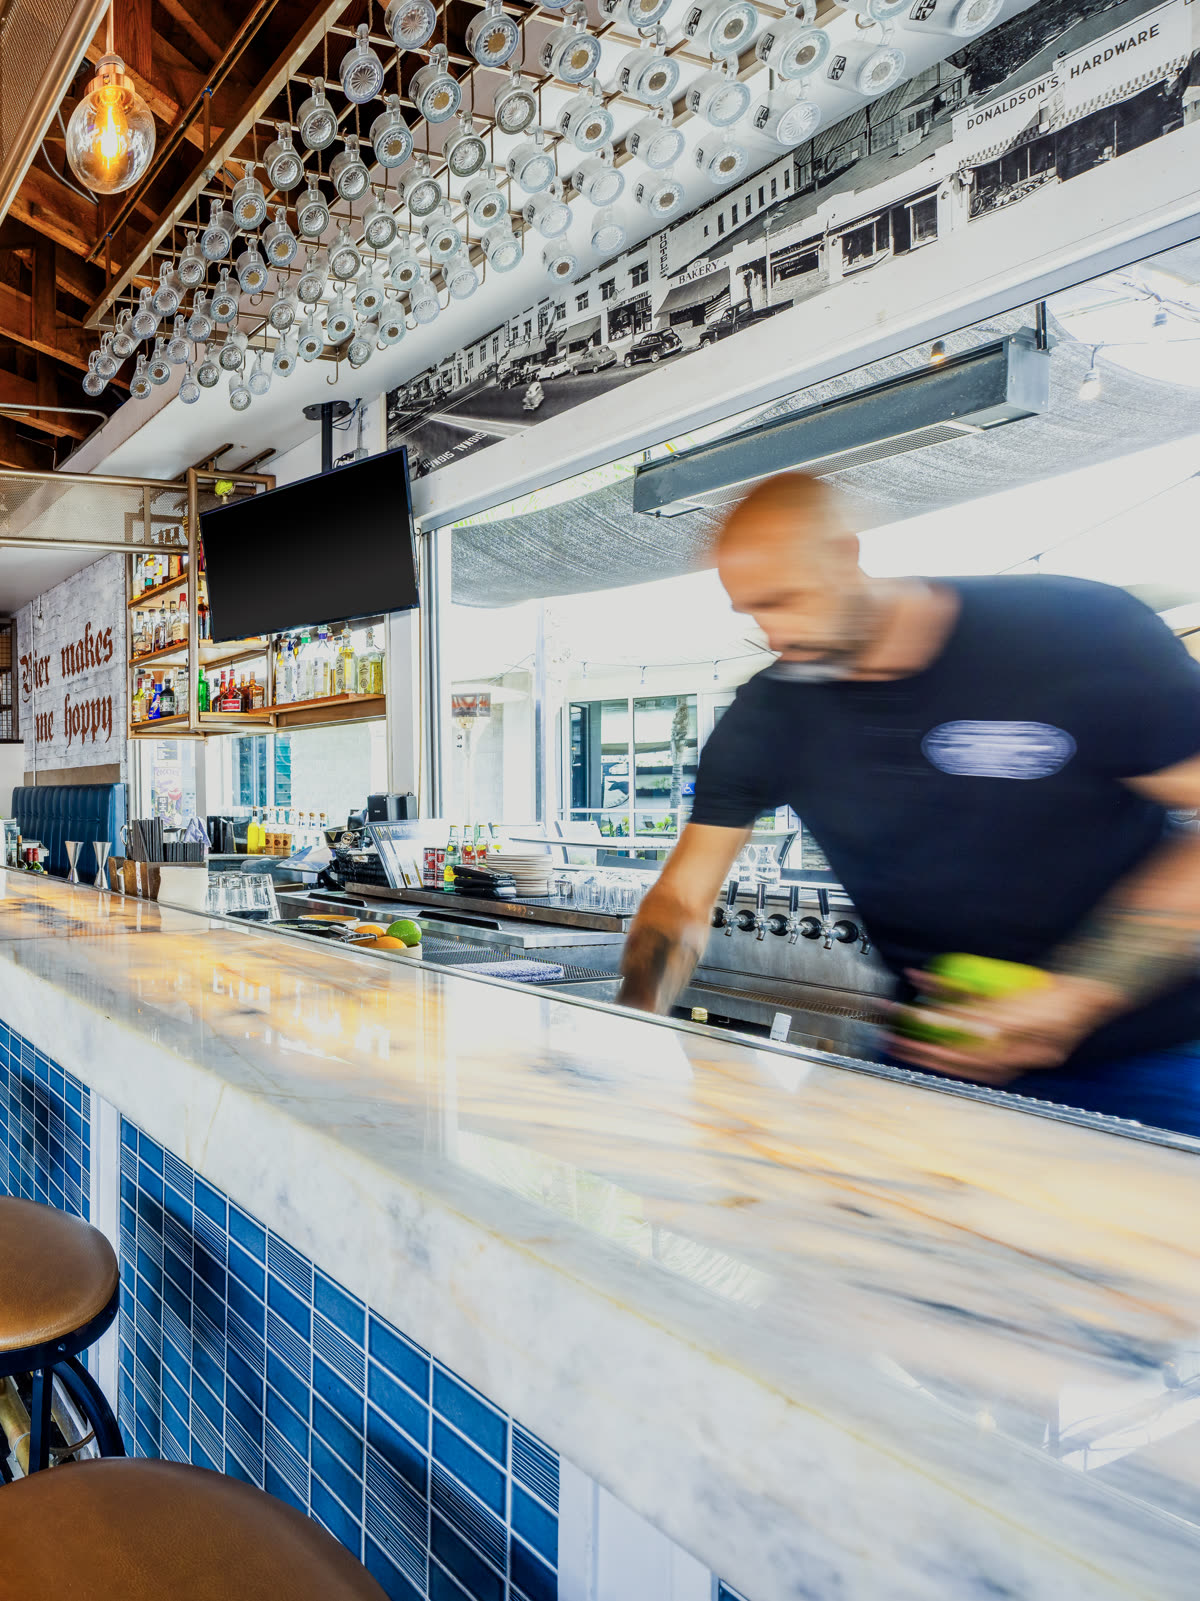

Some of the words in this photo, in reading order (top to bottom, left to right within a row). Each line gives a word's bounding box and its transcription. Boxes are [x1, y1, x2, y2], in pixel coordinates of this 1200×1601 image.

[966, 75, 1059, 130] DONALDSON'S
[1070, 23, 1161, 79] HARDWARE
[659, 232, 669, 271] HOTEL
[678, 259, 720, 285] BAKERY
[452, 431, 489, 452] SIGNAL
[19, 649, 51, 703] Bier
[60, 620, 114, 679] makes
[35, 710, 55, 744] me
